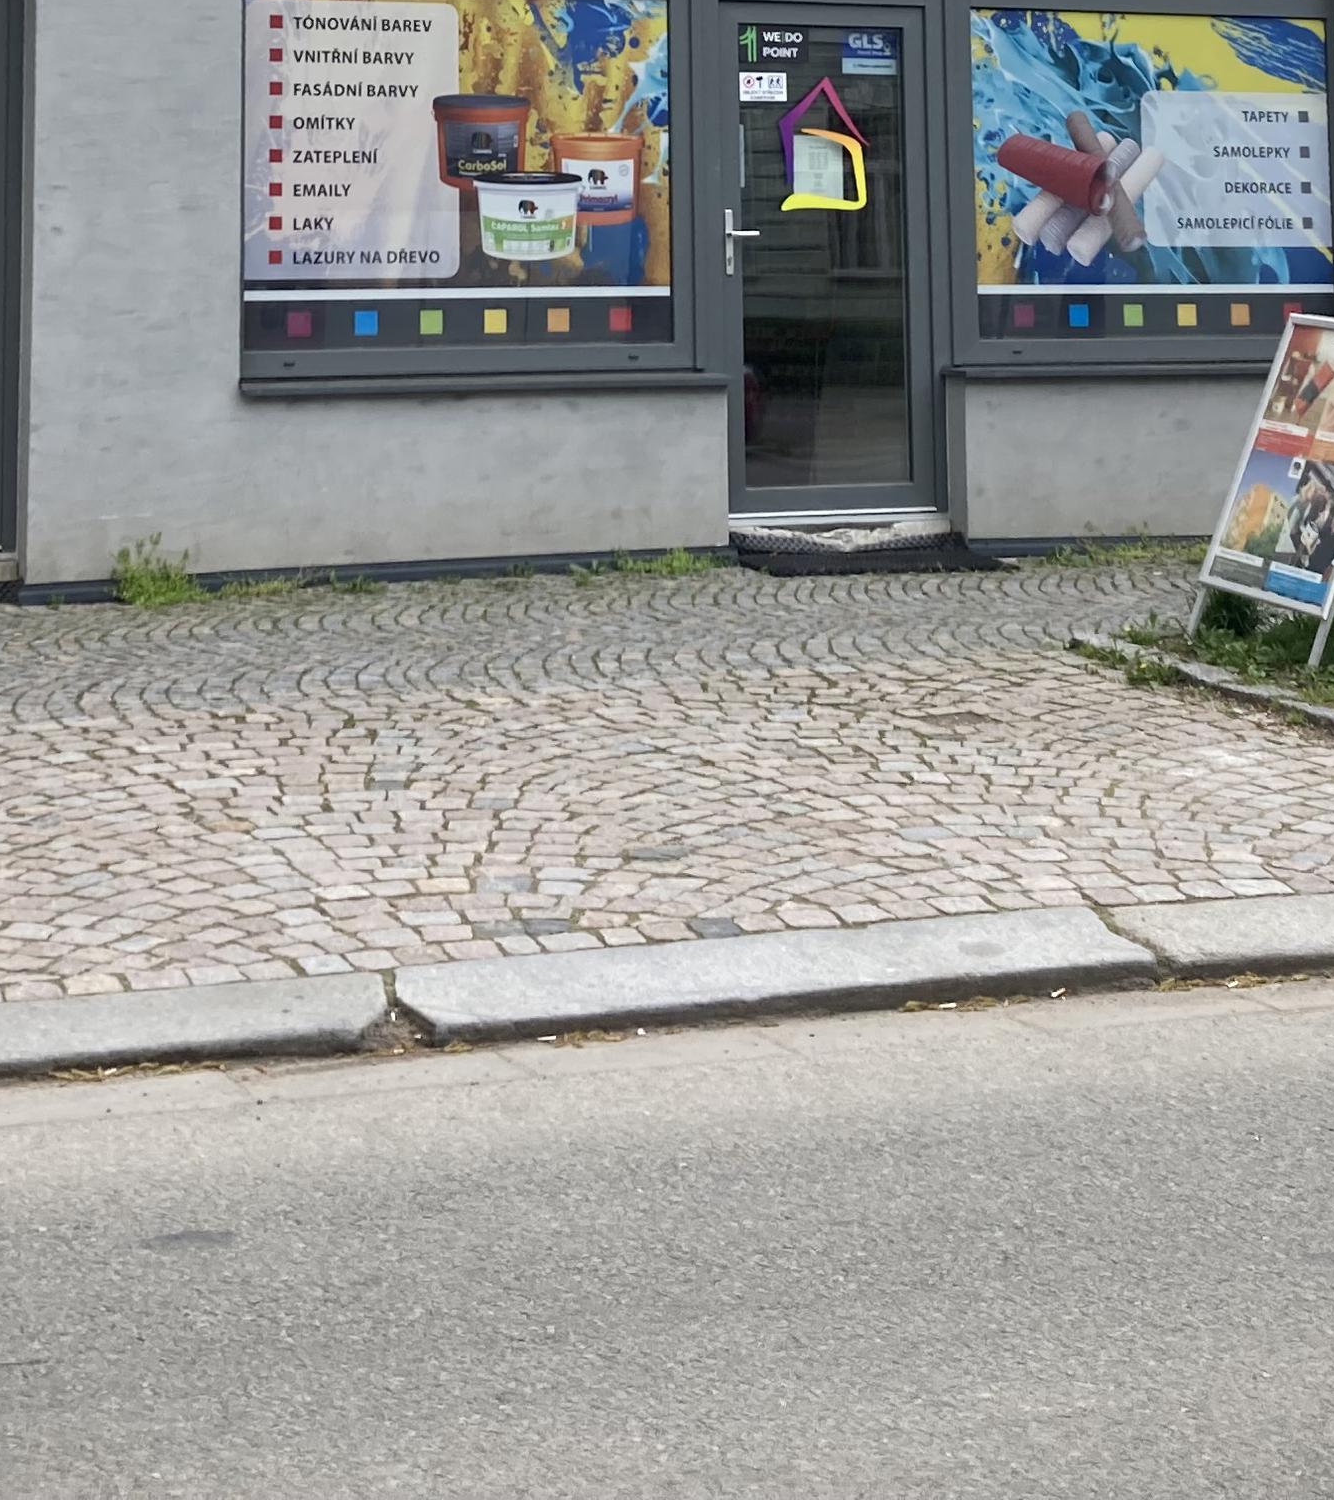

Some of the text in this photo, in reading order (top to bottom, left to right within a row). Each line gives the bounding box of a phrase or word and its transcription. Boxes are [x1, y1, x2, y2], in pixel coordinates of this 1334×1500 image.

[294, 13, 433, 32] TÓNOVÁNÍ BAREV
[848, 33, 884, 49] GLS
[293, 47, 415, 66] VNITŘNÍ BARVY
[762, 47, 799, 58] POINT
[293, 80, 419, 98] FASÁDNÍ BARVY
[293, 113, 356, 131] OMÍTKY
[1242, 110, 1289, 124] TAPETY
[293, 147, 378, 165] ZATEPLENÍ
[1213, 146, 1290, 159] SAMOLEPKY
[458, 158, 507, 173] CarboSol
[293, 183, 352, 197] EMAILY
[1224, 181, 1292, 194] DEKORACE
[293, 217, 335, 231] LAKY
[1177, 215, 1256, 230] SAMOLEPICÍ
[293, 248, 441, 265] LAZURY NA DŘEVO
